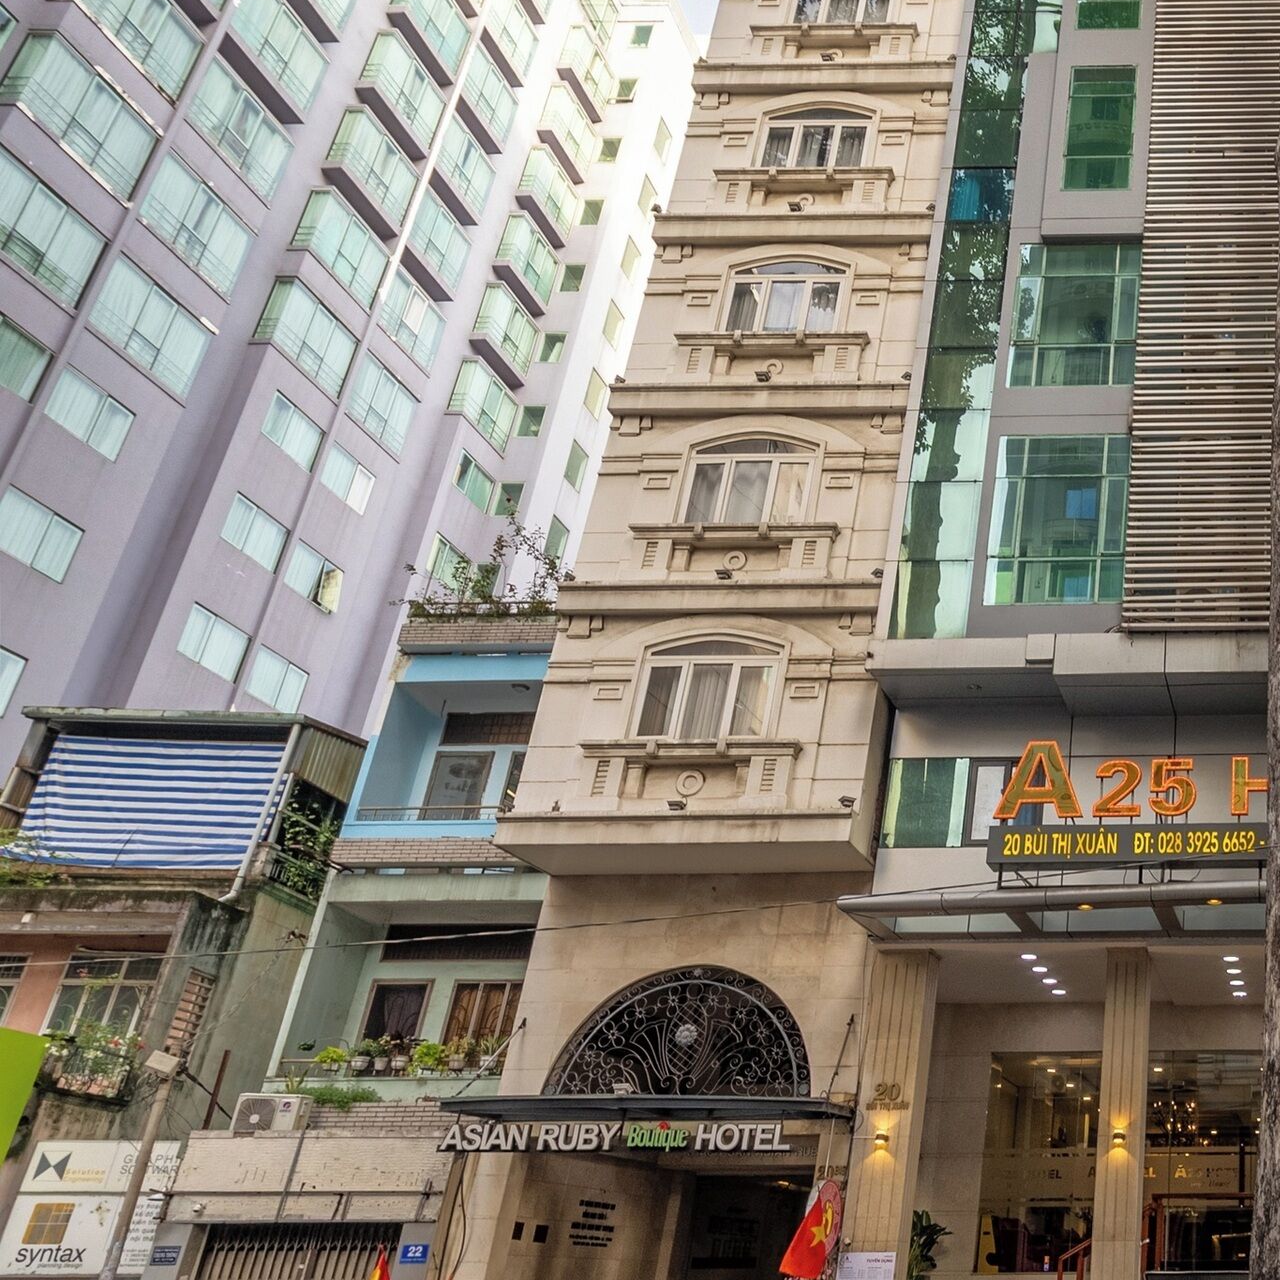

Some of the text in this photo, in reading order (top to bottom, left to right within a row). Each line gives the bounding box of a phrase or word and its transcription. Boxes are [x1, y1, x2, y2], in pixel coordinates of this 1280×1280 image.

[993, 741, 1196, 818] A25
[1003, 833, 1020, 855] 20
[1024, 828, 1047, 855] BÙI
[1051, 833, 1072, 859] THỊ
[1075, 828, 1117, 854] XUÂN
[1134, 832, 1154, 854] ĐT:
[1158, 832, 1183, 854] 028
[1186, 831, 1218, 853] 3925
[1222, 831, 1255, 853] 6652
[873, 1082, 901, 1101] 20
[438, 1123, 791, 1152] ASIAN RUBY Boutique HOTEL
[15, 1245, 87, 1268] syntax
[407, 1245, 423, 1257] 22
